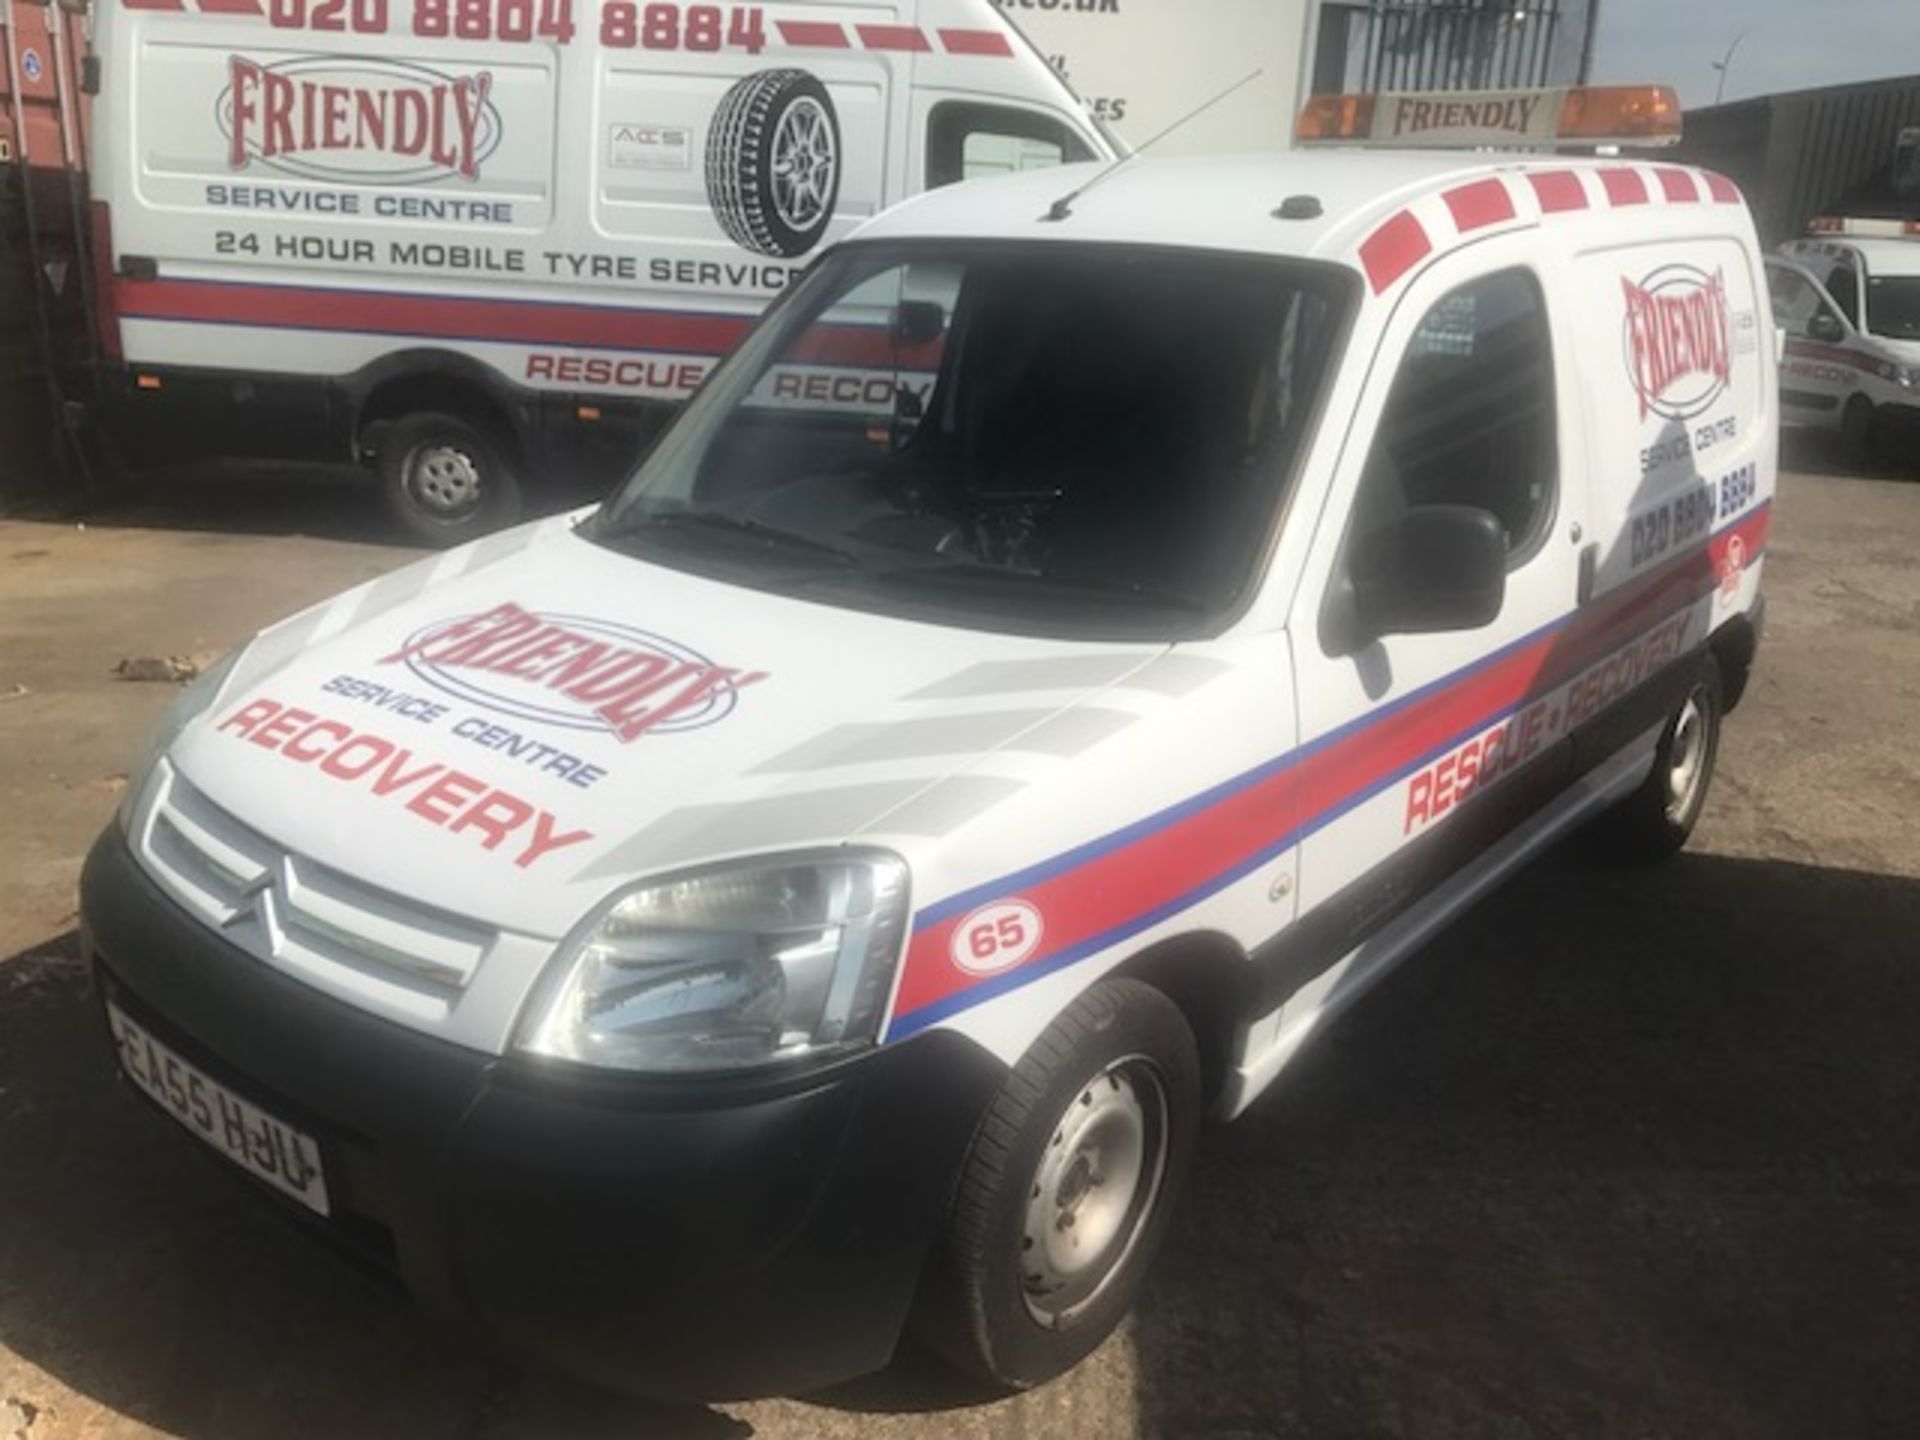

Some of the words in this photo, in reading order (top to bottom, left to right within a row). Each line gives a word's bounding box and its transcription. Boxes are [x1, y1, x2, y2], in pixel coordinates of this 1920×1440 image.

[269, 0, 388, 34] 020
[412, 0, 575, 44] 8804
[600, 2, 765, 54] 8884
[229, 54, 492, 180] FRIENDLY
[1392, 93, 1541, 137] FRIENDLY
[206, 185, 359, 214] SERVICE
[374, 196, 513, 223] CENTRE
[215, 231, 260, 255] 24
[276, 234, 375, 262] HOUR
[391, 242, 525, 271] MOBILE
[543, 252, 637, 279] TYRE
[526, 353, 704, 389] RESCUE
[1620, 264, 1730, 423] FRIENDLY
[1639, 434, 1691, 475] SERVICE
[1696, 416, 1736, 451] CENTRE
[1631, 504, 1670, 568] 020
[1720, 461, 1756, 520] 8884
[375, 601, 771, 744] FRIENDLY
[321, 673, 450, 724] SERVICE
[452, 715, 608, 789] CENTRE
[1403, 707, 1542, 836] RESCUE
[1562, 608, 1693, 734] RECOVERY
[217, 697, 596, 869] RECOVERY
[969, 913, 1025, 959] 65
